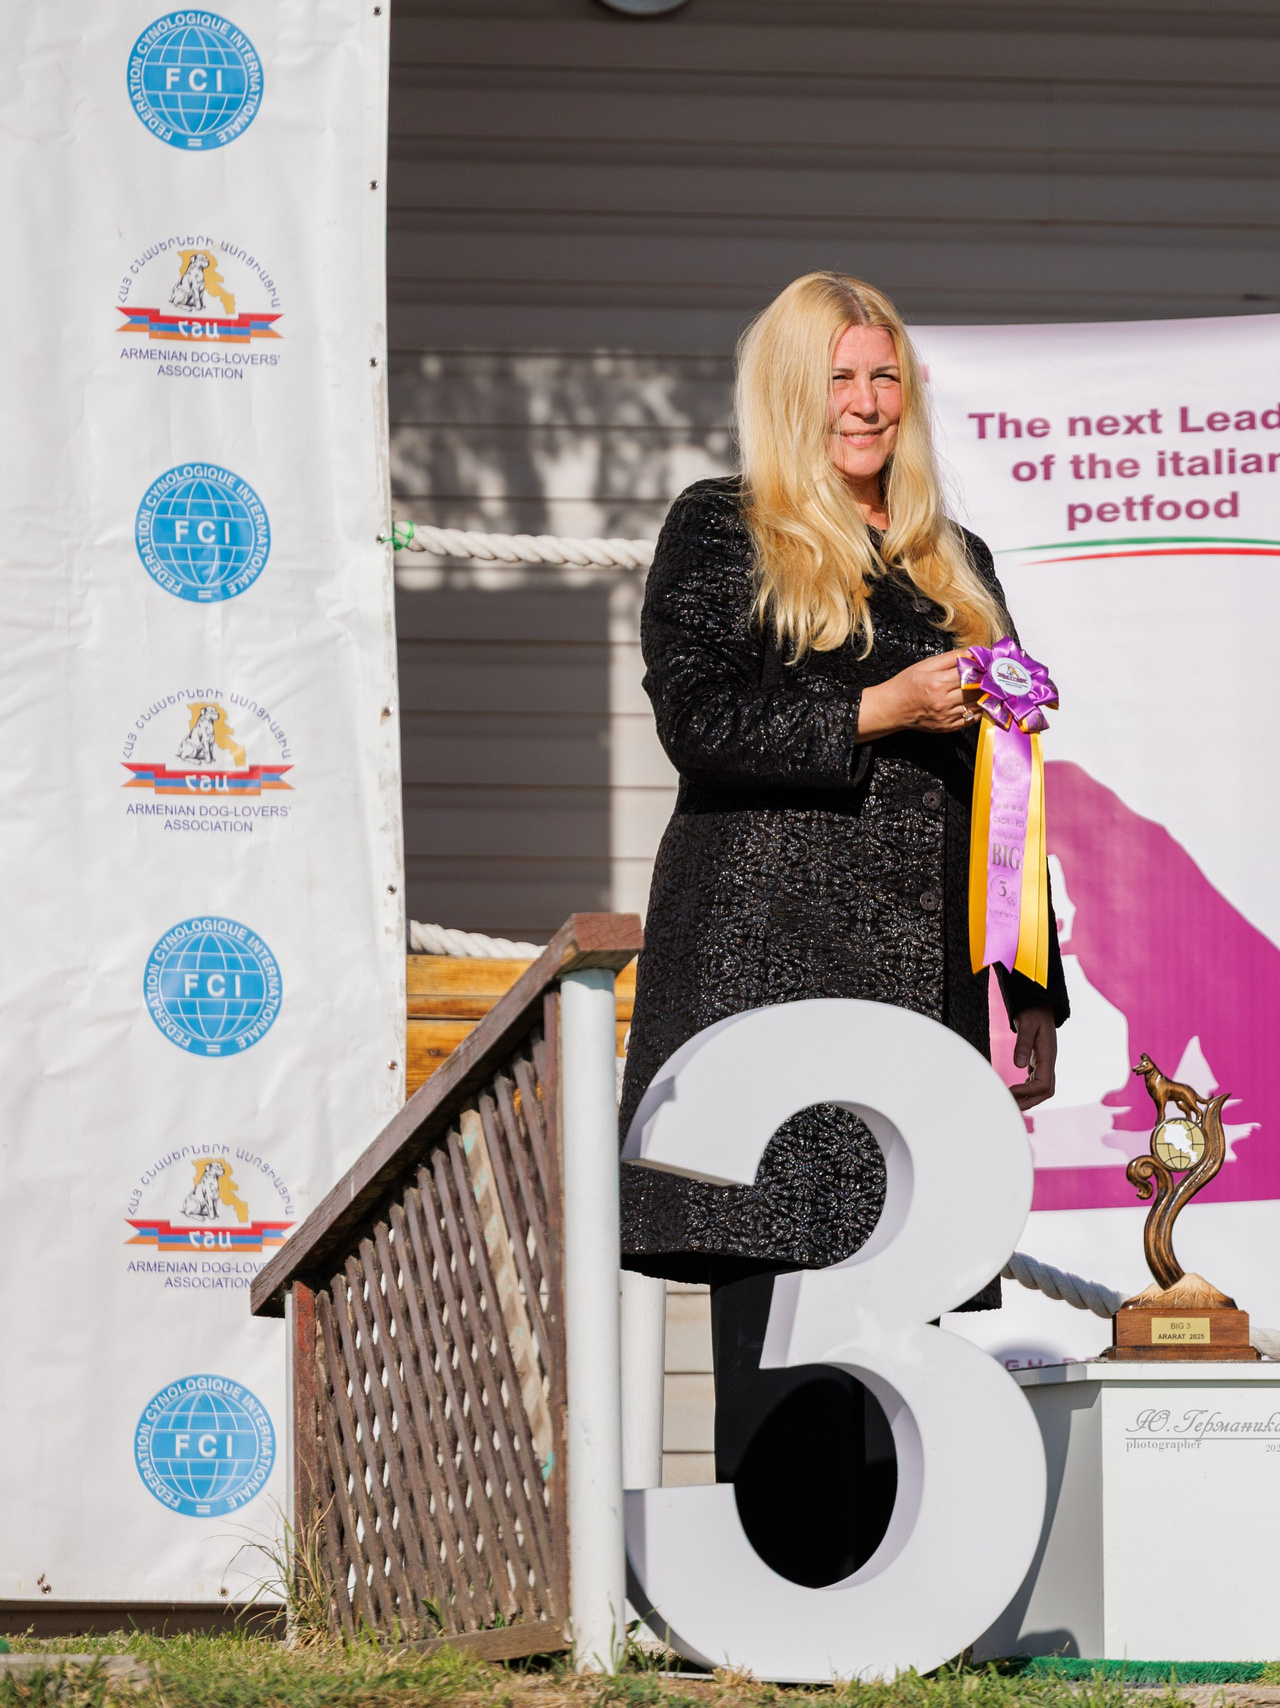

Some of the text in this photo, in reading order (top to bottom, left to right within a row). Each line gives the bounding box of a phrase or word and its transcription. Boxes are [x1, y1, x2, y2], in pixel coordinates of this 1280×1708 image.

[130, 12, 261, 143] FEDERATION CYNOLOGIQUE INTERNATIONALE
[166, 67, 222, 92] FCI
[121, 348, 187, 362] ARMENIAN
[157, 364, 243, 379] ASSOCIATION
[968, 411, 1051, 439] The
[1067, 408, 1163, 436] next
[1012, 454, 1056, 482] of
[1070, 452, 1140, 480] the
[1067, 491, 1240, 531] petfood
[138, 465, 268, 595] FEDERATION CYNOLOGIQUE INTERNATIONALE
[175, 520, 230, 545] FCI
[126, 803, 195, 816] ARMENIAN
[164, 819, 253, 832] ASSOCIATION
[992, 842, 1021, 870] BIG
[998, 880, 1007, 897] 3
[147, 919, 279, 1049] FEDERATION CYNOLOGIQUE INTERNATIONALE
[184, 973, 241, 998] FCI
[127, 1261, 267, 1273] ARMENIAN DOG-LOV
[1170, 1322, 1191, 1330] BIG 3
[621, 998, 1047, 1683] 3
[137, 1377, 272, 1510] FEDERATION CYNOLOGIQUE INTERNATIONALE
[175, 1434, 233, 1458] FCI
